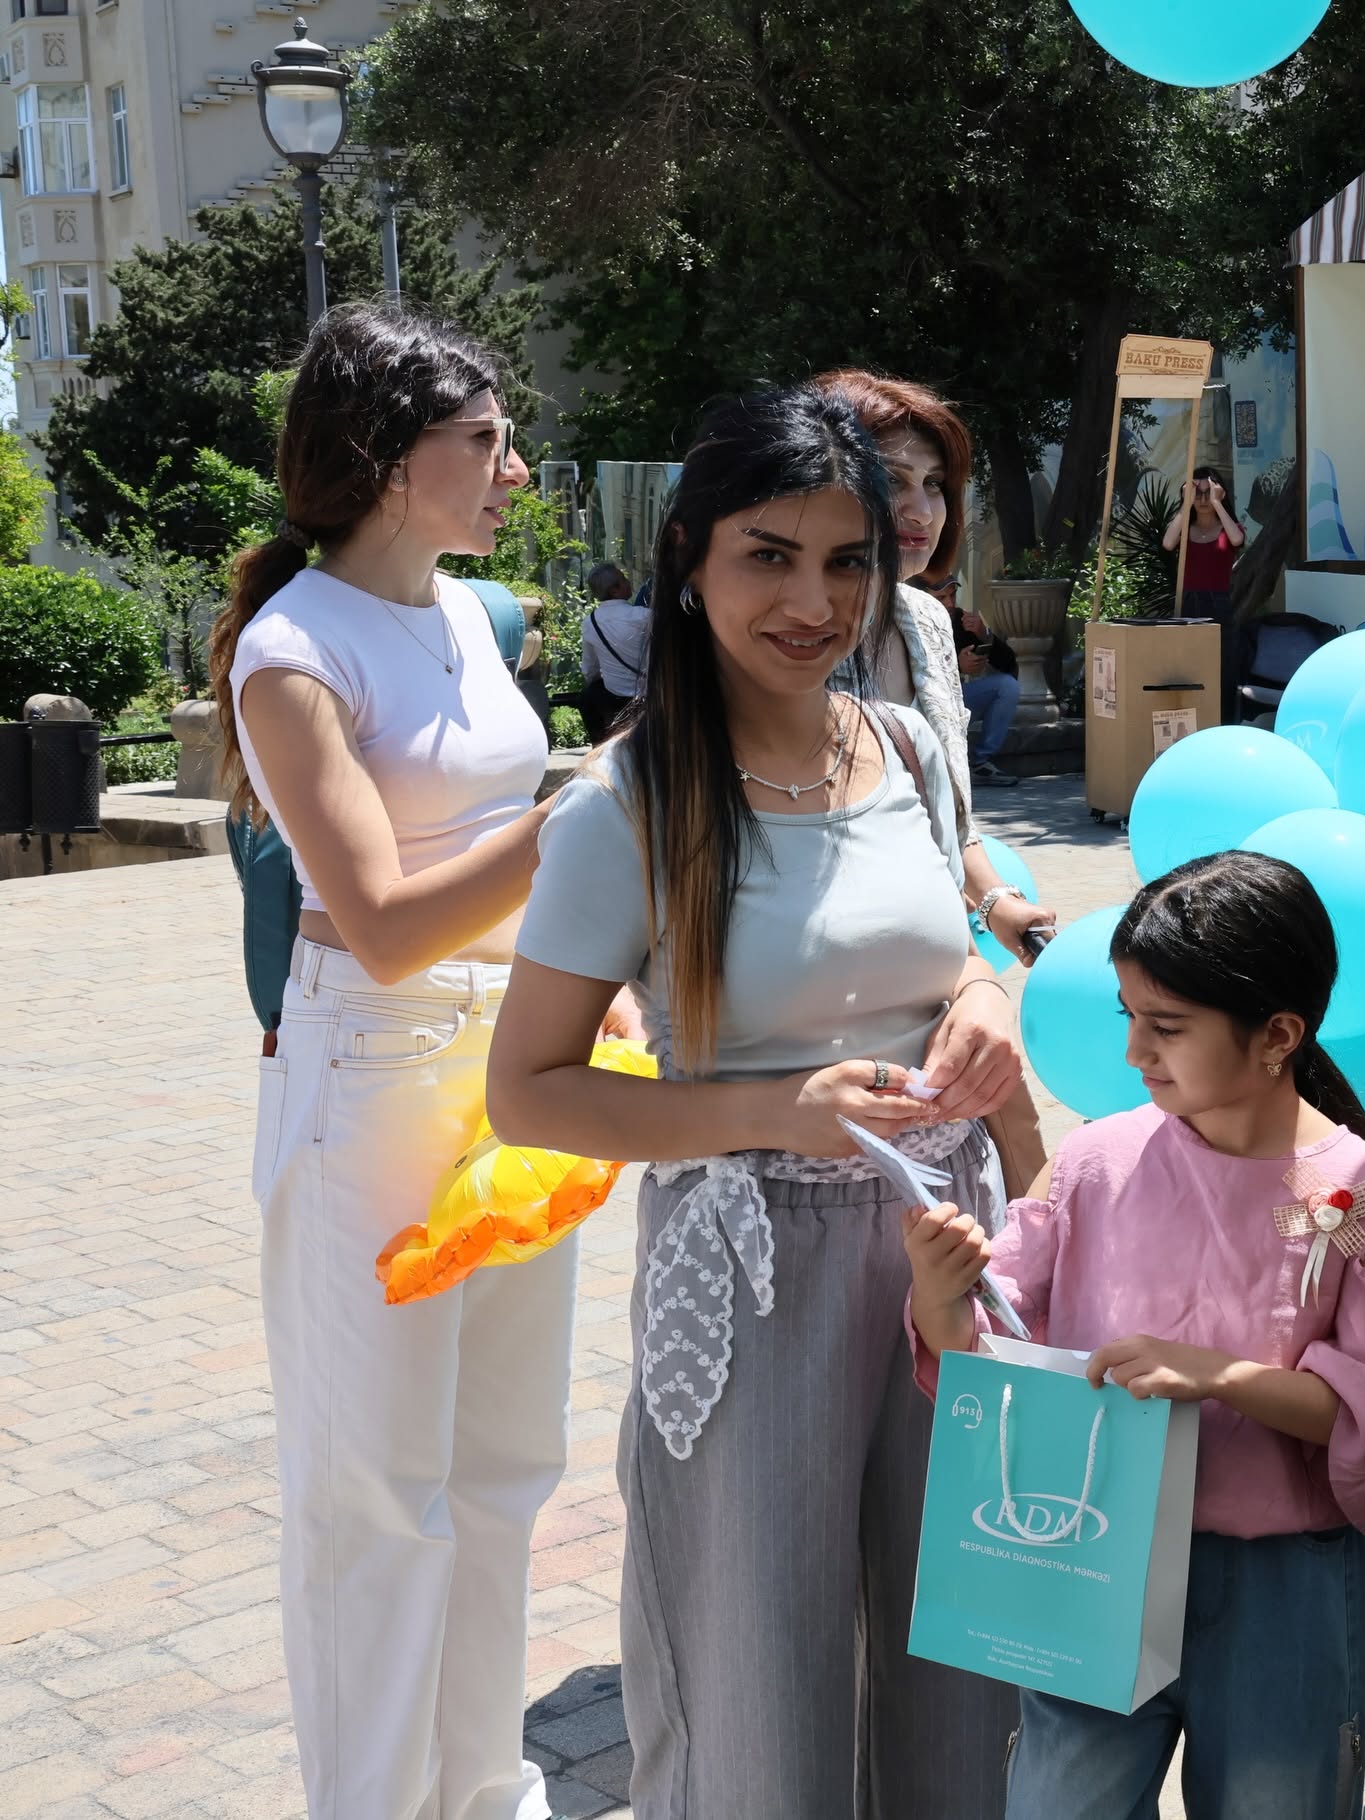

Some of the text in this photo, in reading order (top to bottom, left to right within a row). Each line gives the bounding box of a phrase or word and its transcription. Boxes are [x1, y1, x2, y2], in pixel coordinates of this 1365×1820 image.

[1125, 352, 1204, 370] BAKU PRESS
[959, 1406, 976, 1417] 913
